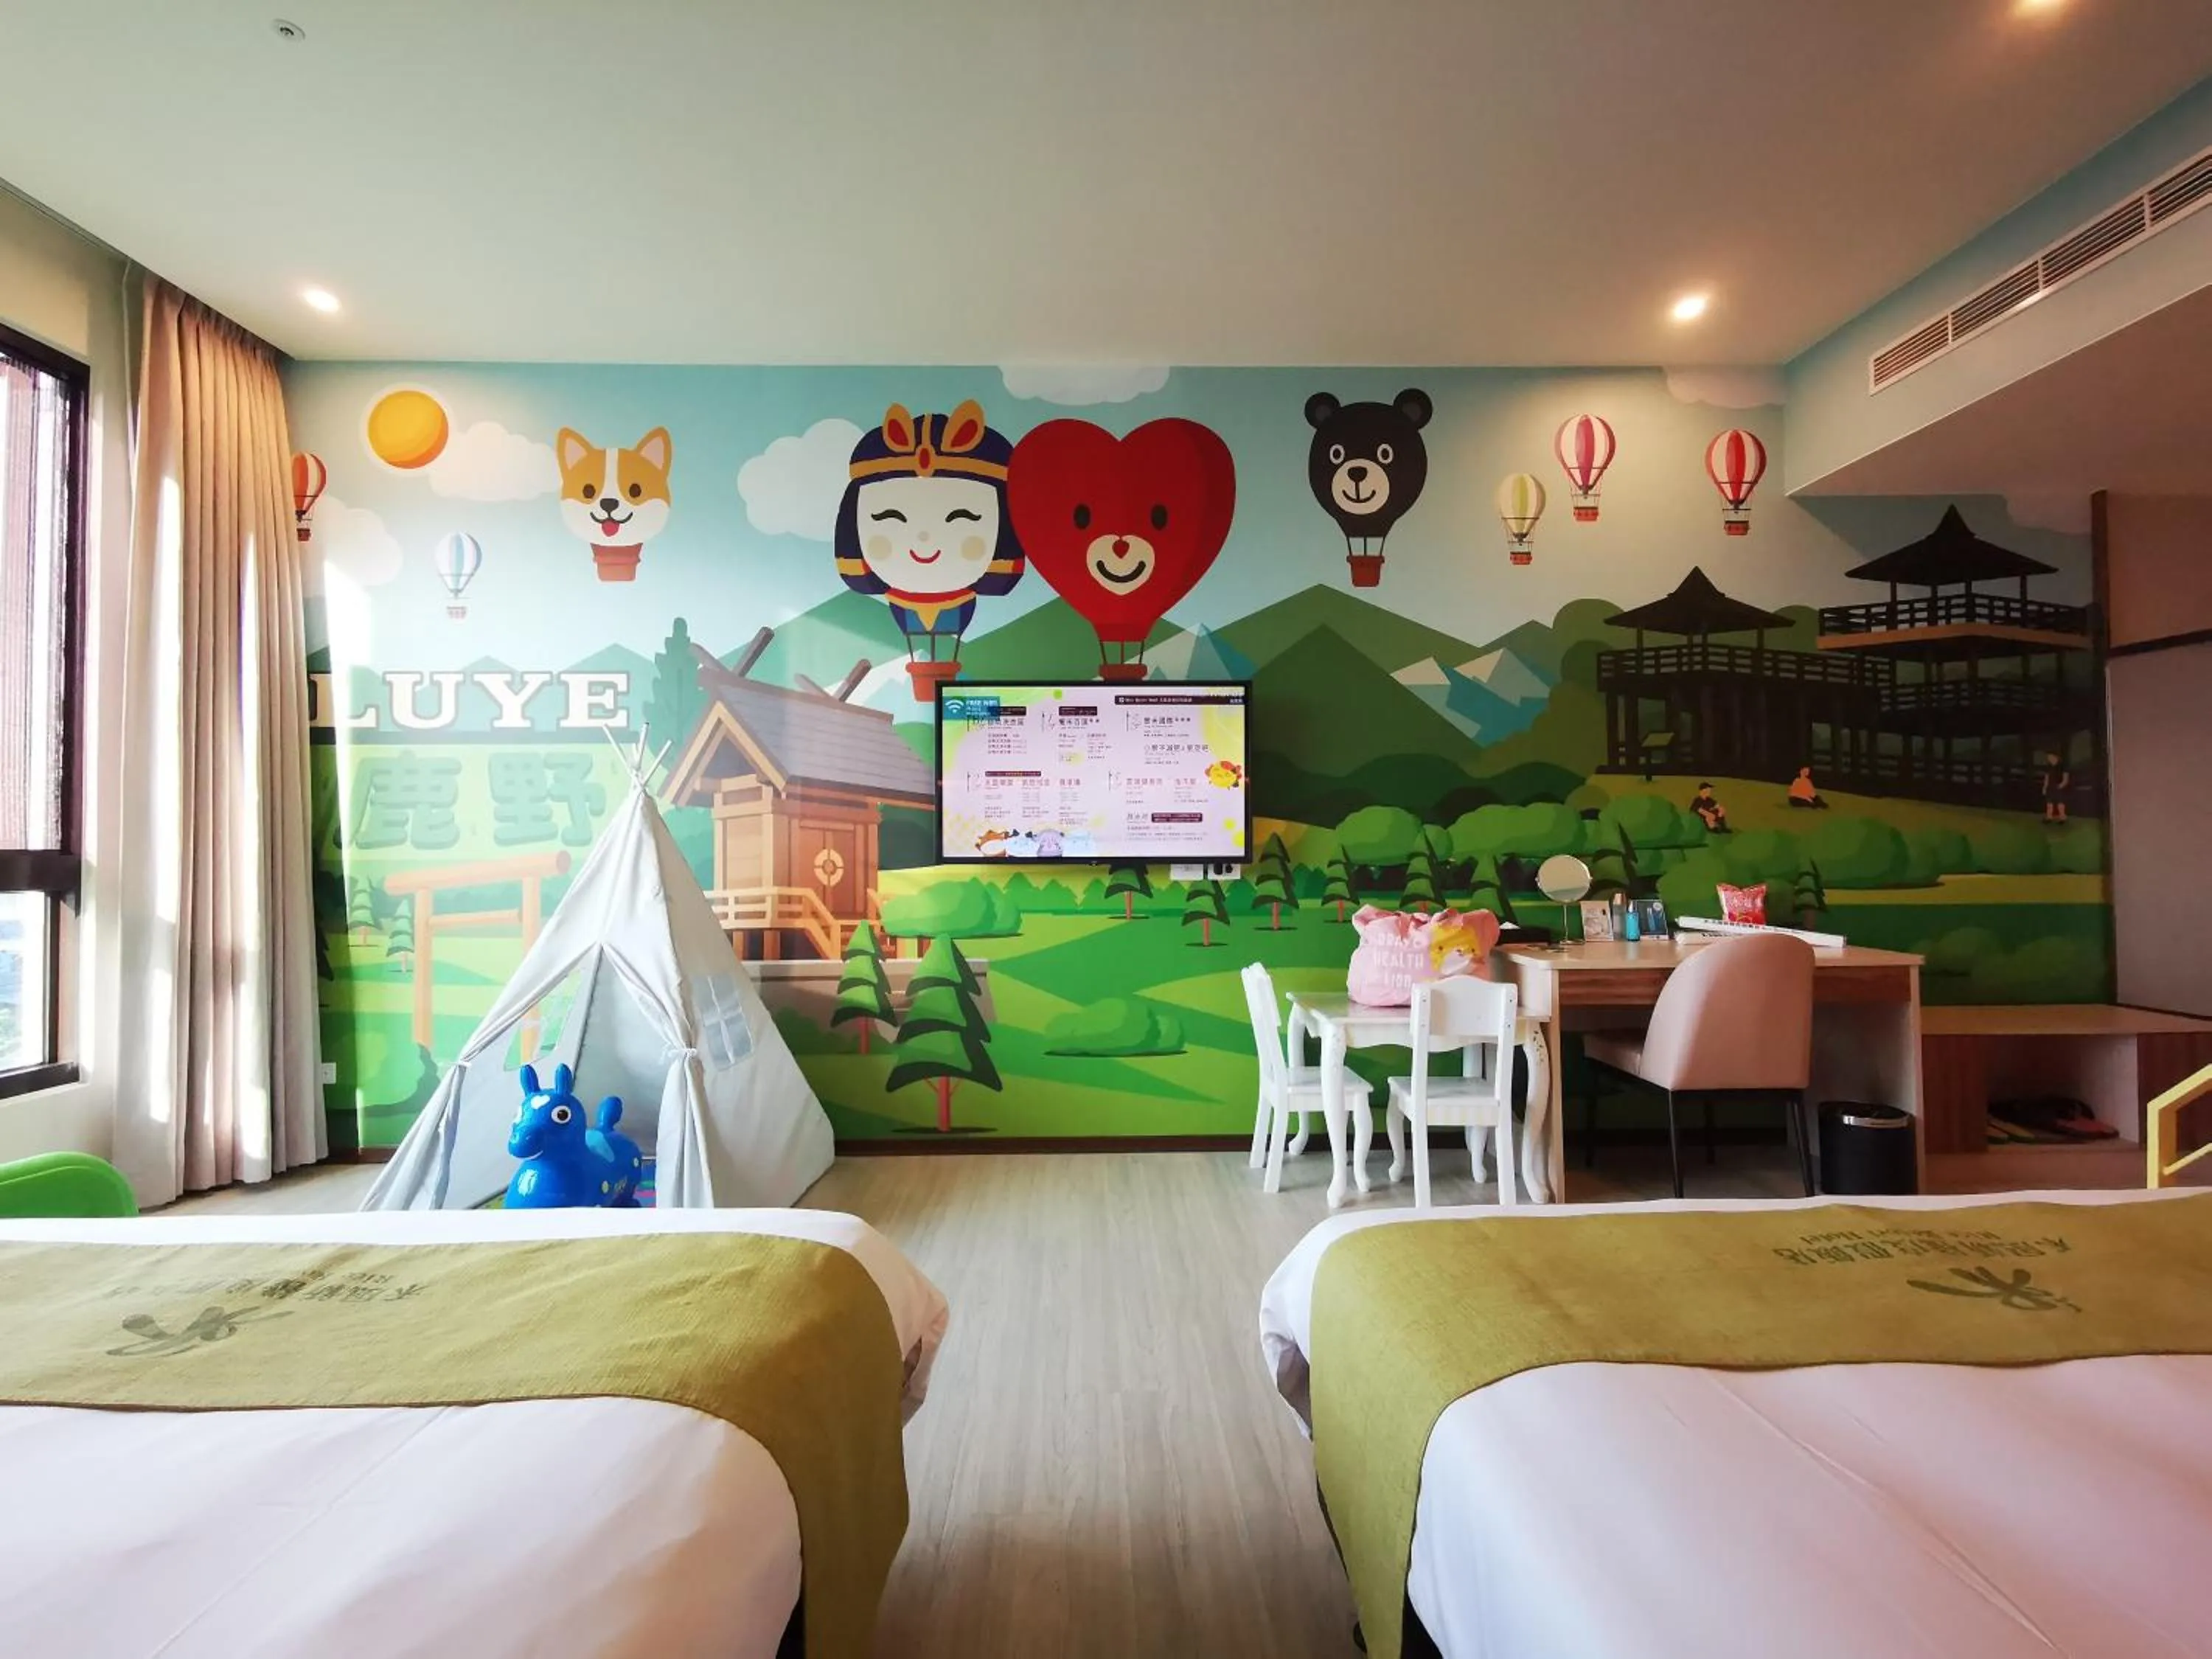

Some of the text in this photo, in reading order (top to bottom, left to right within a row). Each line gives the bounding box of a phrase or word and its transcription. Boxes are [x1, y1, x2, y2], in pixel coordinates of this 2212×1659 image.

[308, 672, 629, 728] LUYE
[333, 748, 607, 850] 鹿野
[1373, 948, 1425, 969] HEALTH
